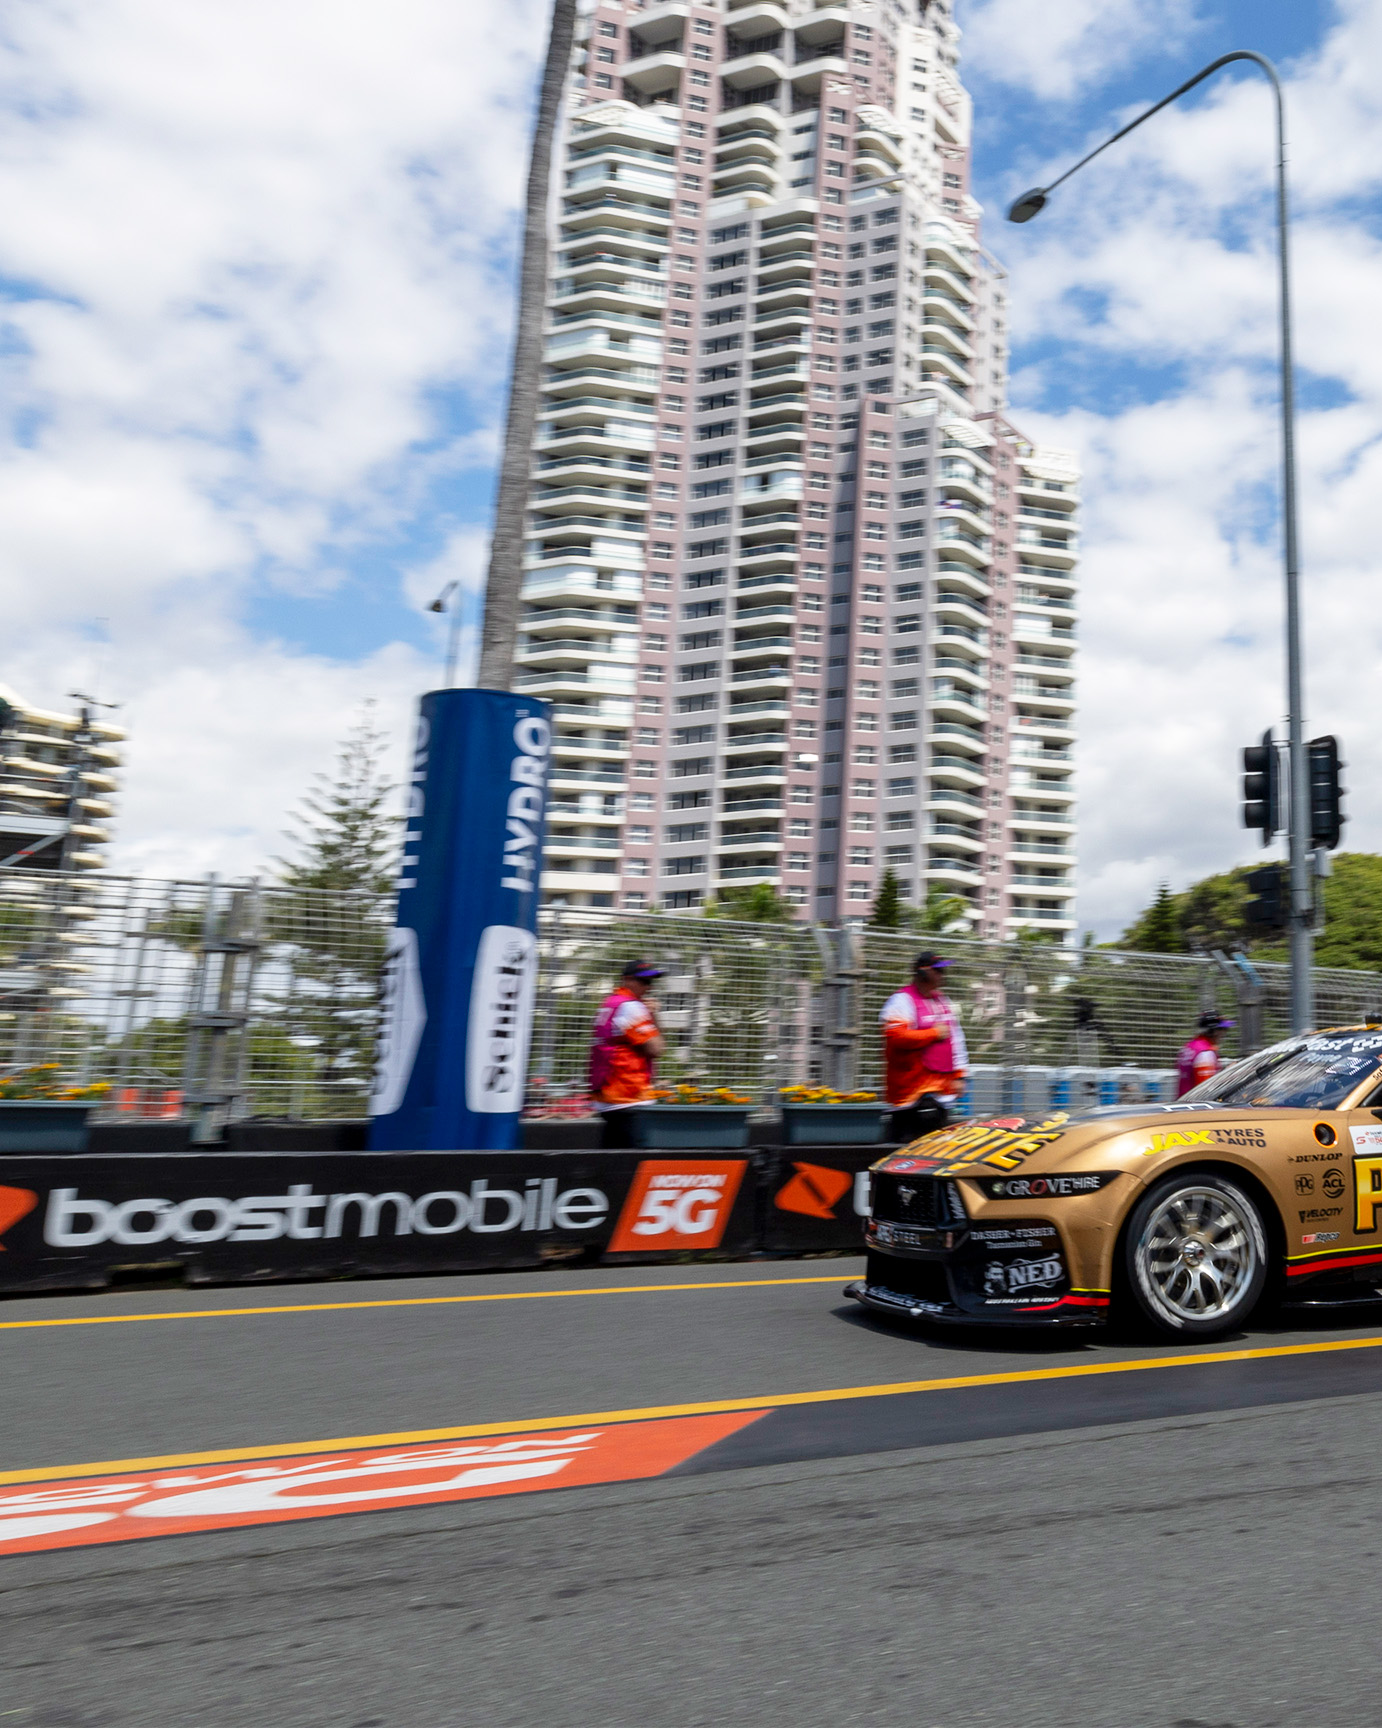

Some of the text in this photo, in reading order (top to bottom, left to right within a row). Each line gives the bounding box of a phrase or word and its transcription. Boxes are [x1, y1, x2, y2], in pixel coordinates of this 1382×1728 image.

[501, 716, 551, 893] HYDRO
[1144, 1128, 1264, 1155] JAX TYRES
[1228, 1137, 1266, 1148] AUTO
[1295, 1153, 1343, 1163] DUNLOP
[1006, 1178, 1072, 1195] GROVE
[1322, 1178, 1346, 1189] ACL
[44, 1178, 609, 1247] boostmobile
[631, 1189, 724, 1236] 5G
[1009, 1261, 1063, 1286] NED
[0, 1432, 606, 1506] OW ON
